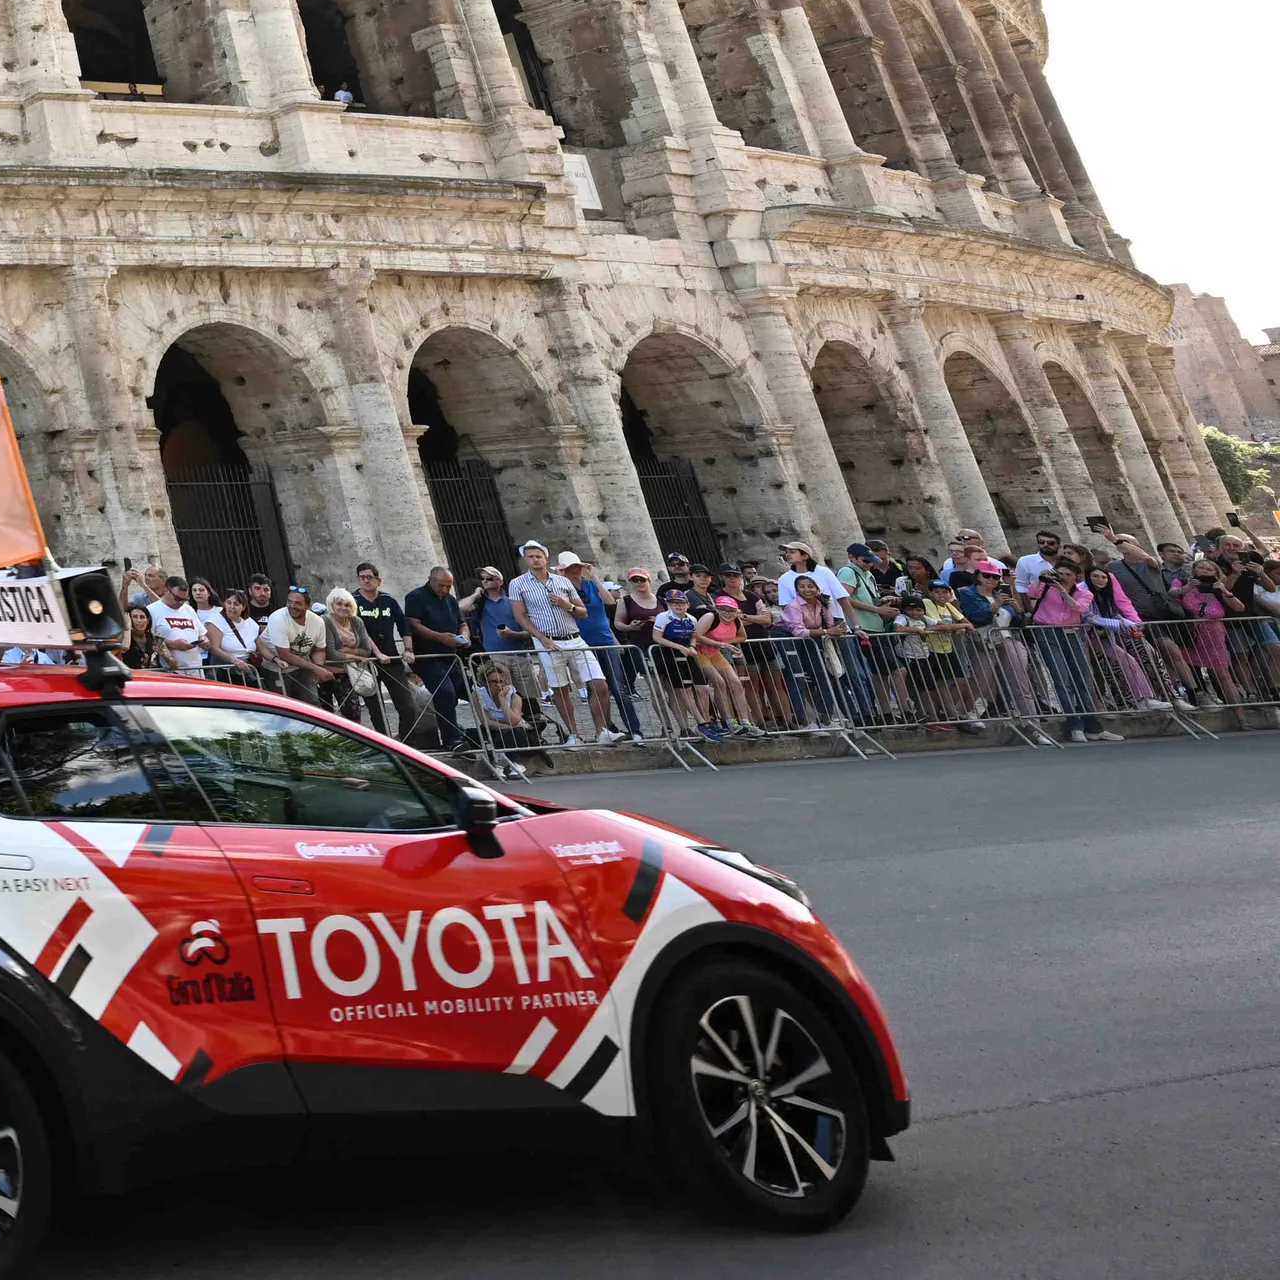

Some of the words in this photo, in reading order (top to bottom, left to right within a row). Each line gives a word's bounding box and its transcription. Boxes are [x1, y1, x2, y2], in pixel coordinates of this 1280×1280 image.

[15, 878, 50, 893] EASY
[53, 876, 91, 892] NEXT
[256, 900, 595, 1000] TOYOTA
[329, 1002, 418, 1023] OFFICIAL
[424, 996, 514, 1017] MOBILITY
[521, 990, 600, 1011] PARTNER
